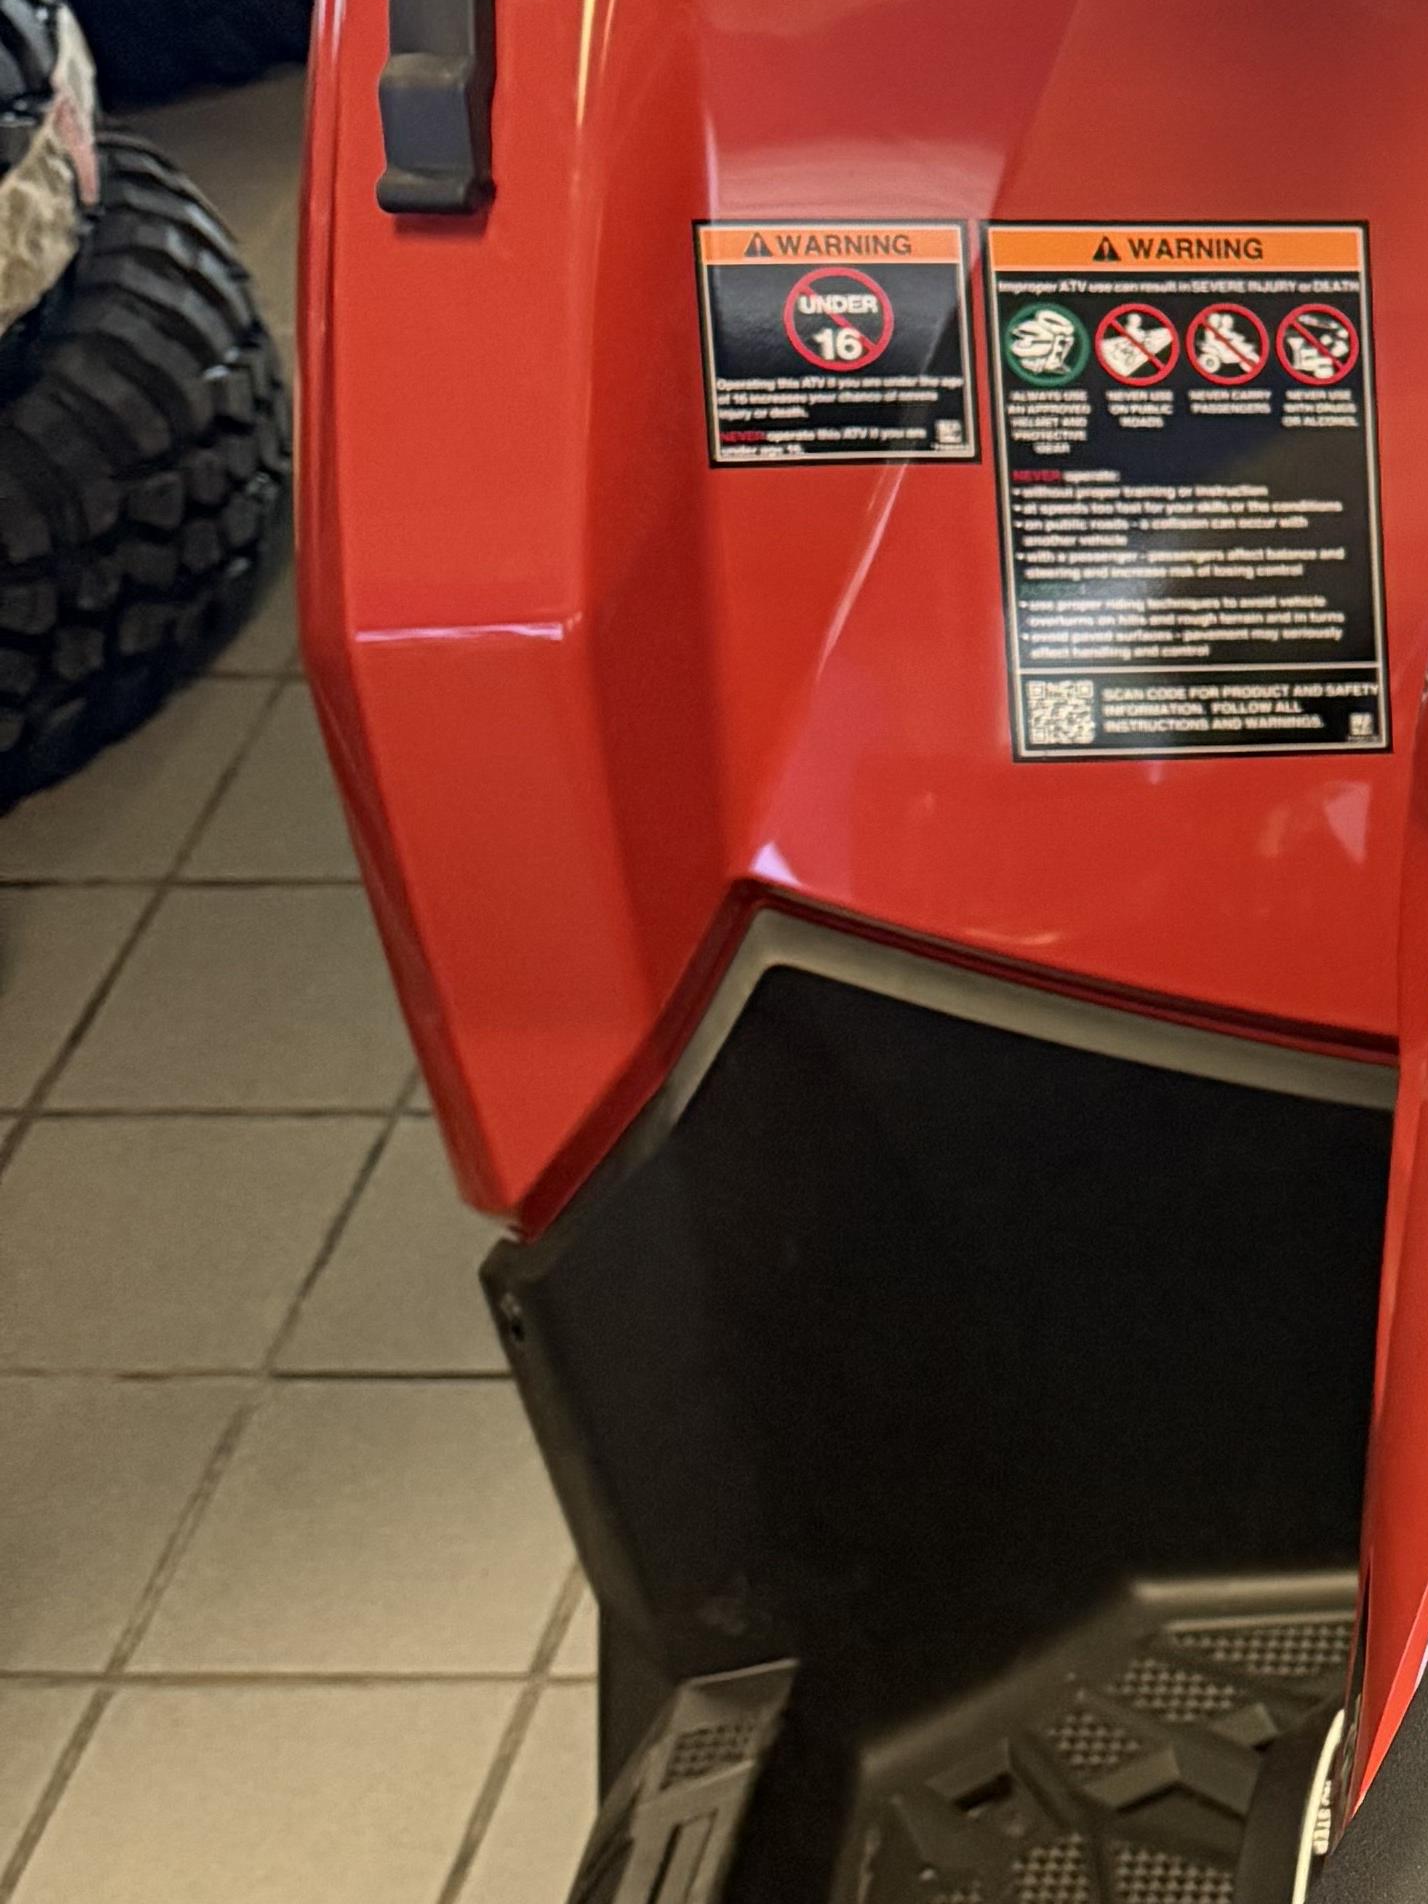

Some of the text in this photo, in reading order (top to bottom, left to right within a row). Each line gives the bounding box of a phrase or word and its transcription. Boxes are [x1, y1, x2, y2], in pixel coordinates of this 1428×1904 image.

[776, 235, 912, 256] WARNING
[1128, 237, 1264, 261] WARNING
[799, 294, 878, 315] UNDER
[814, 328, 863, 360] 16
[1104, 683, 1378, 702] SCAN CODE FOR PRODUCT AND SAFETY
[1212, 701, 1271, 714] FOLLOW
[1275, 701, 1303, 712] ALL
[1212, 717, 1242, 729] AND
